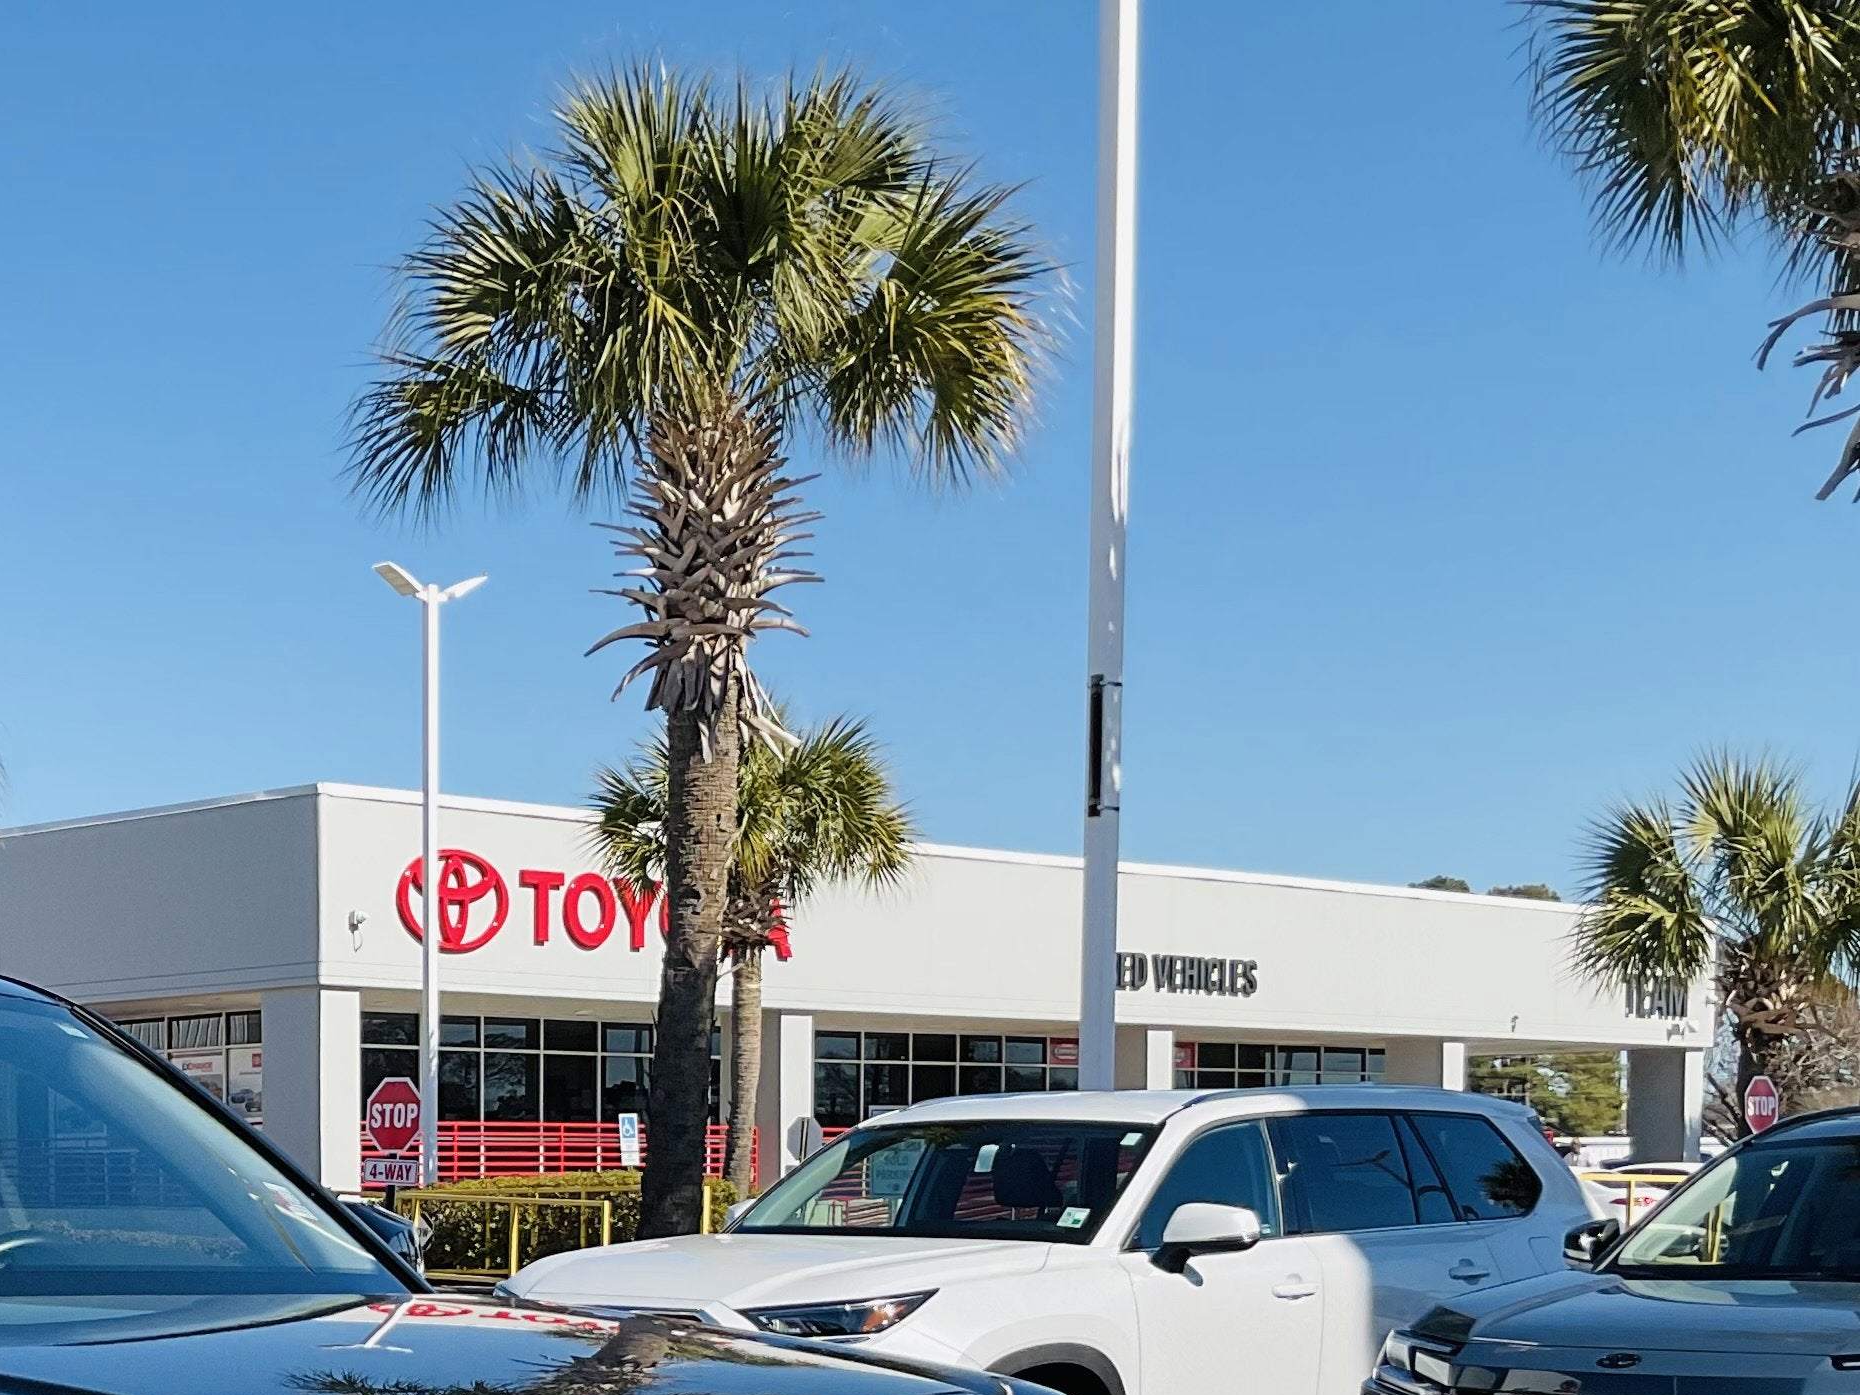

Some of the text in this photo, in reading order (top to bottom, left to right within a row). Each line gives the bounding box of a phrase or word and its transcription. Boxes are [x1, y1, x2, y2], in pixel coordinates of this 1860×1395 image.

[520, 868, 793, 961] TOY
[1115, 952, 1258, 997] ED VEHICLES
[370, 1102, 419, 1129] STOP
[1747, 1096, 1777, 1117] STOP
[369, 1163, 412, 1182] 4-WAY
